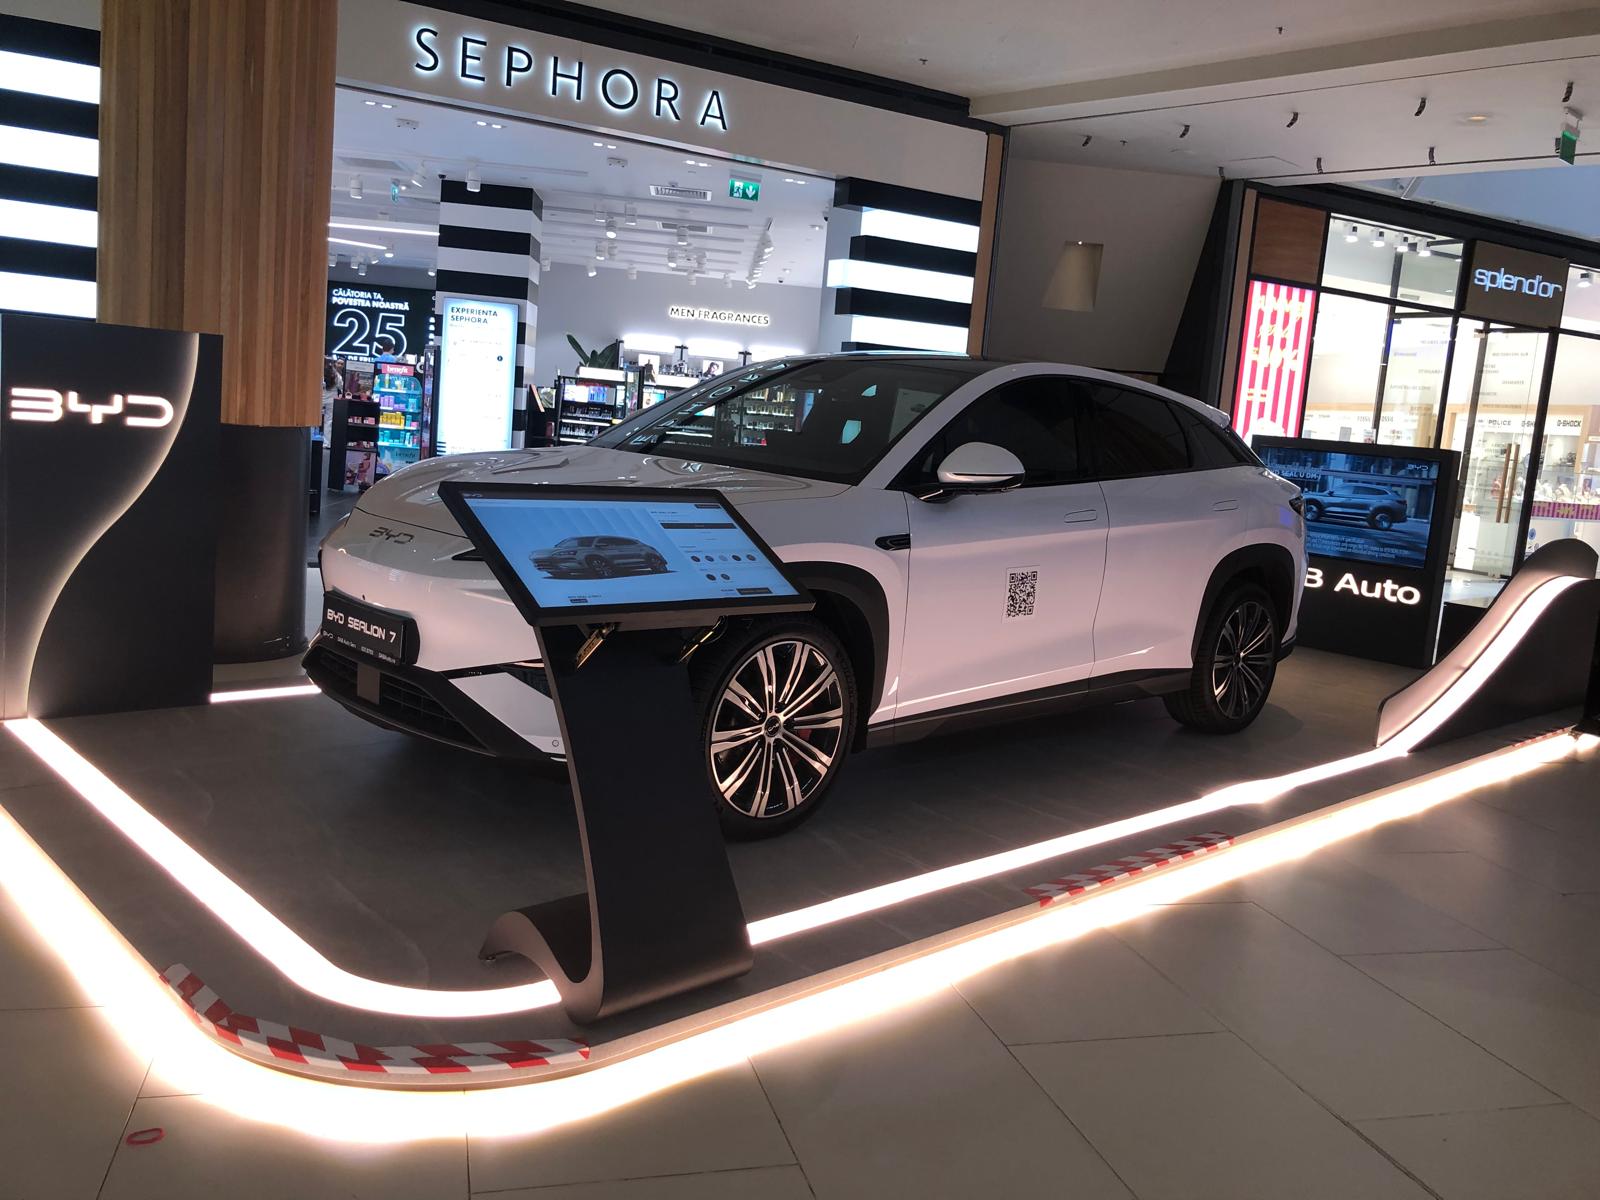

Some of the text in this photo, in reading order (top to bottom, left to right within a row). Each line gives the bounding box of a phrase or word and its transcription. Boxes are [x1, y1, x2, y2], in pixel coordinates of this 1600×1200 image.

[414, 27, 728, 131] SEPHORA
[332, 288, 372, 299] CĂLĂTORIA
[332, 297, 410, 311] POVESTEA NOASTRĂ
[450, 315, 489, 324] SEPHORA
[670, 307, 769, 325] MEN FRAGRANCES
[332, 308, 407, 358] 25
[386, 365, 408, 374] benefit
[10, 387, 174, 428] BYD
[1488, 419, 1512, 427] POLICE
[1556, 419, 1581, 428] G-SHOCK
[1407, 463, 1429, 471] BYD
[369, 526, 415, 544] BYD
[1333, 572, 1421, 605] Auto
[326, 608, 397, 643] BYD SEALION 7
